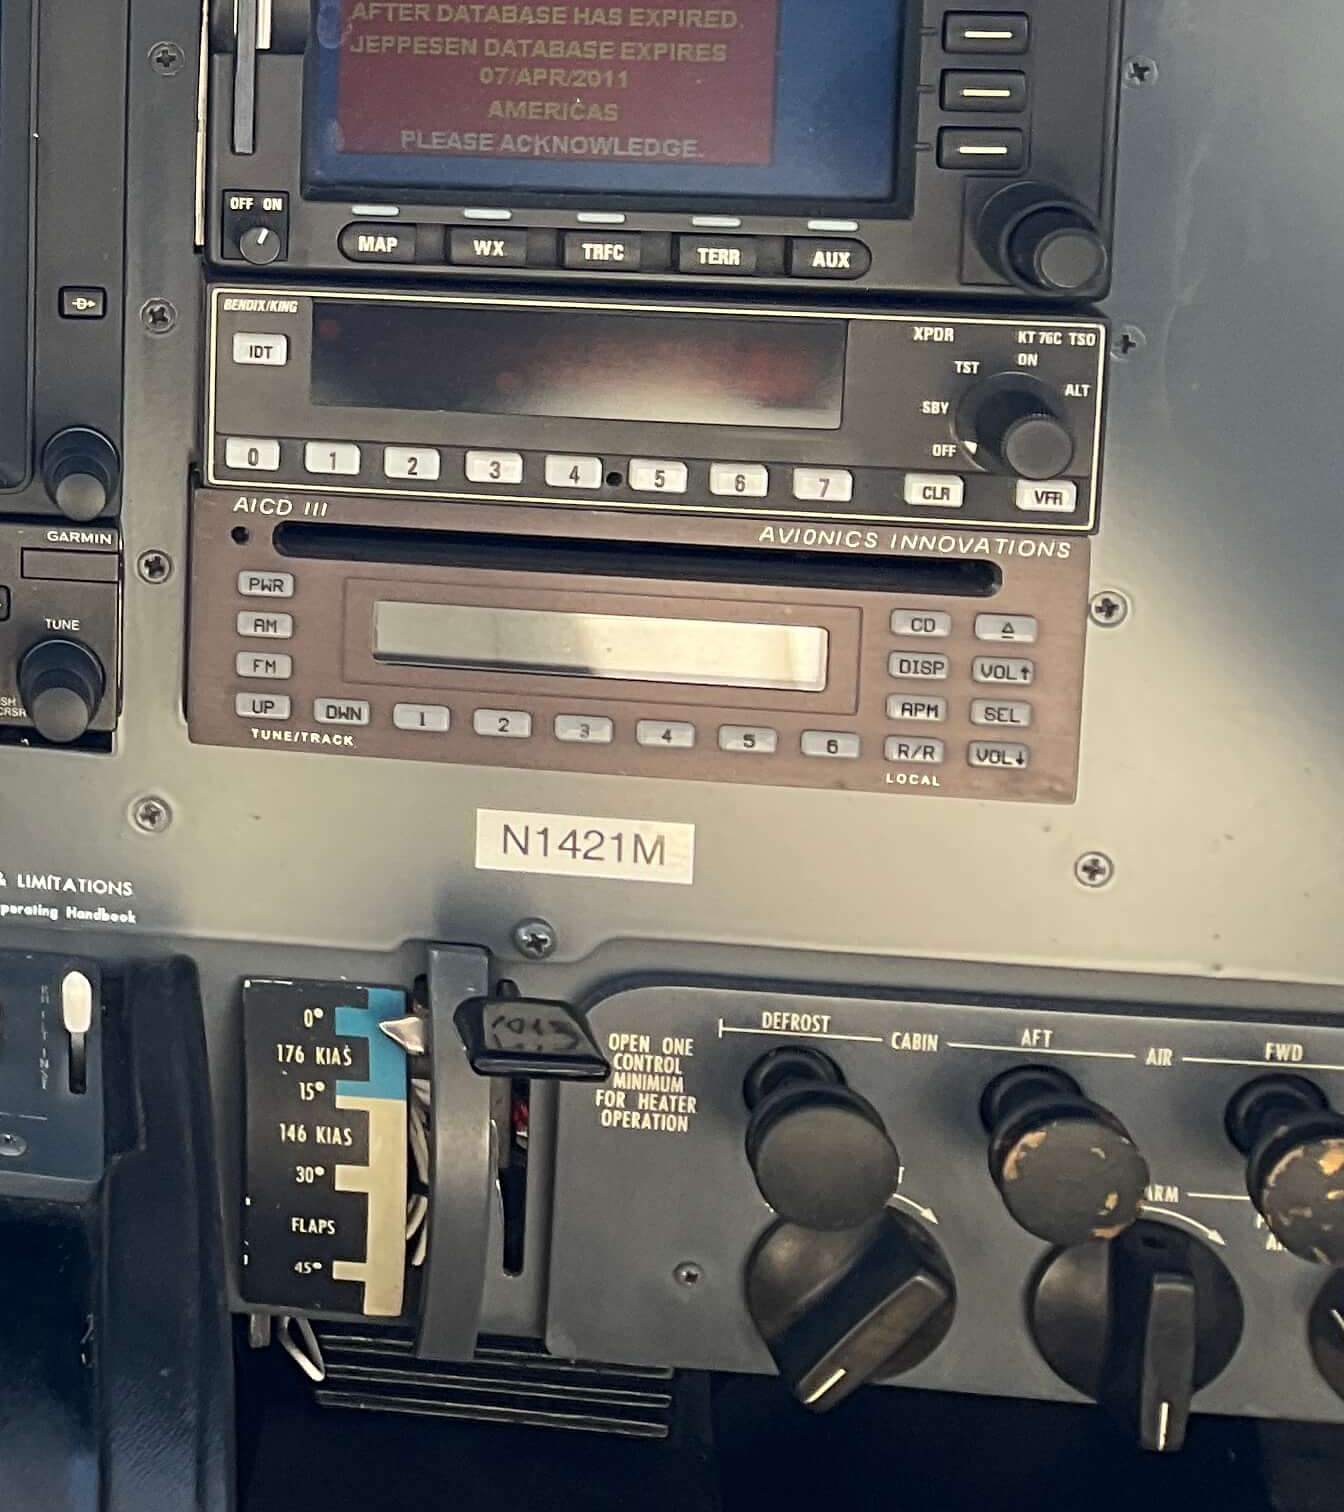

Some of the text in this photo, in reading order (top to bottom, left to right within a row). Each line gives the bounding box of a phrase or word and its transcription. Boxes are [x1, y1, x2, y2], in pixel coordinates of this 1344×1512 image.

[488, 101, 618, 122] AMERICAS
[358, 236, 398, 253] MAP
[698, 247, 740, 266] TERR
[812, 250, 850, 269] AUX
[913, 325, 954, 343] XPDR
[890, 534, 1071, 559] INNOVATIONS
[503, 824, 664, 866] N1421M
[17, 874, 133, 896] LIMITATIONS
[762, 1011, 830, 1033] DEFROST
[609, 1033, 693, 1056] OPEN ONE
[890, 1032, 939, 1051] CABIN
[1266, 1043, 1303, 1061] FWD
[614, 1053, 682, 1074] CONTROL
[614, 1073, 684, 1092] MINIMUM
[596, 1091, 696, 1113] FOR HEATER
[601, 1112, 689, 1133] OPERATION
[292, 1217, 335, 1234] FLAPS
